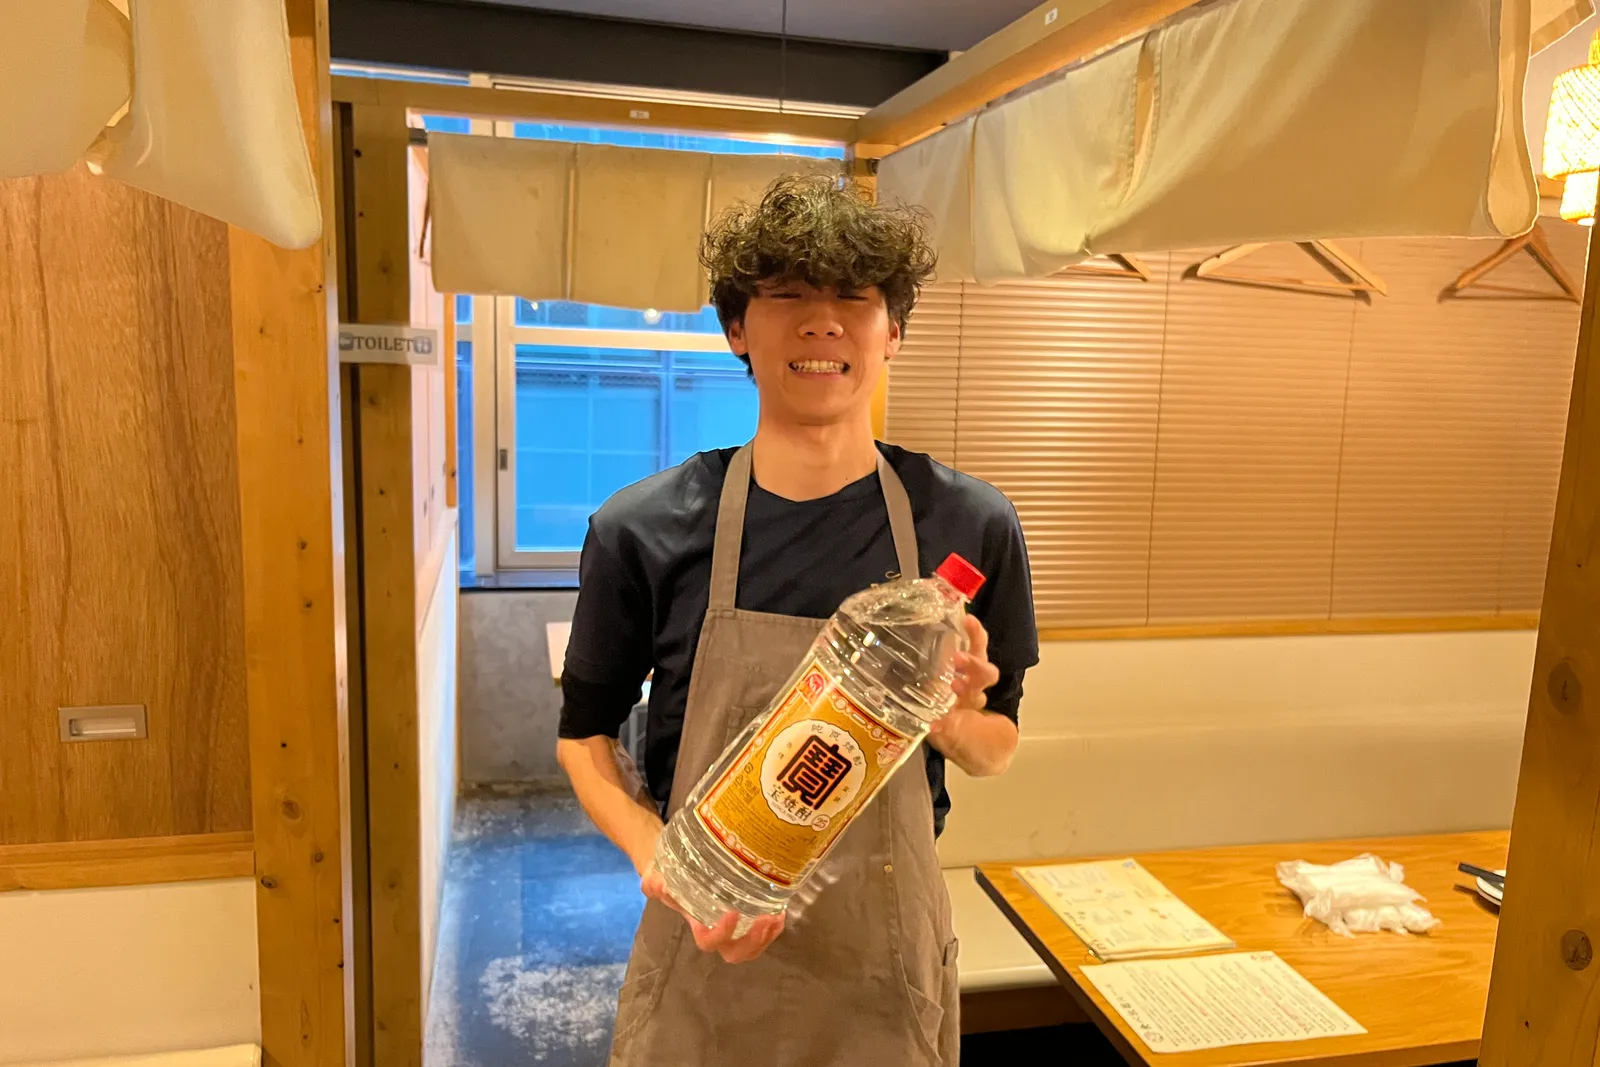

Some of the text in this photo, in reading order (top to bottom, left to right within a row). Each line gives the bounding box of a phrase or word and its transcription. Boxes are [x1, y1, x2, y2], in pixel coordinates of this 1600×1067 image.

[354, 335, 413, 352] TOILET
[767, 784, 813, 821] 宝焼酎
[816, 817, 829, 829] 25
